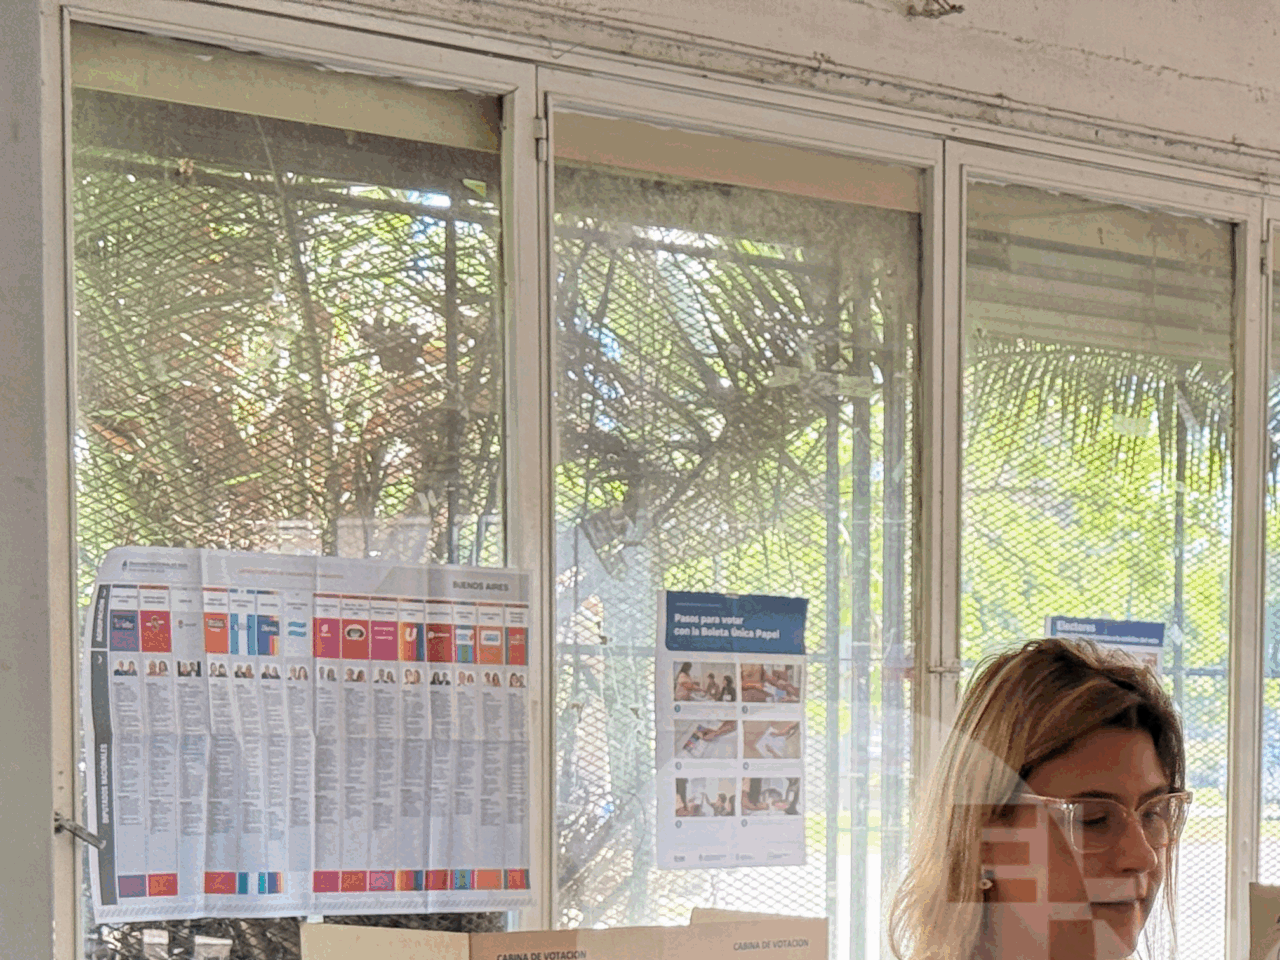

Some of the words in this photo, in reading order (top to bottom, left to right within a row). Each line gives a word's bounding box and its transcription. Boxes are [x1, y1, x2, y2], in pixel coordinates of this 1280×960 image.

[453, 580, 484, 590] BUENOS
[486, 583, 509, 592] AIRES
[674, 613, 699, 623] Pasos
[700, 615, 720, 625] para
[721, 616, 744, 625] votar
[674, 627, 690, 636] con
[692, 626, 700, 636] la
[701, 627, 729, 637] Boleta
[731, 626, 754, 638] Única
[755, 629, 780, 640] Papel
[733, 941, 760, 951] CABINA
[543, 950, 587, 960] VOTACION
